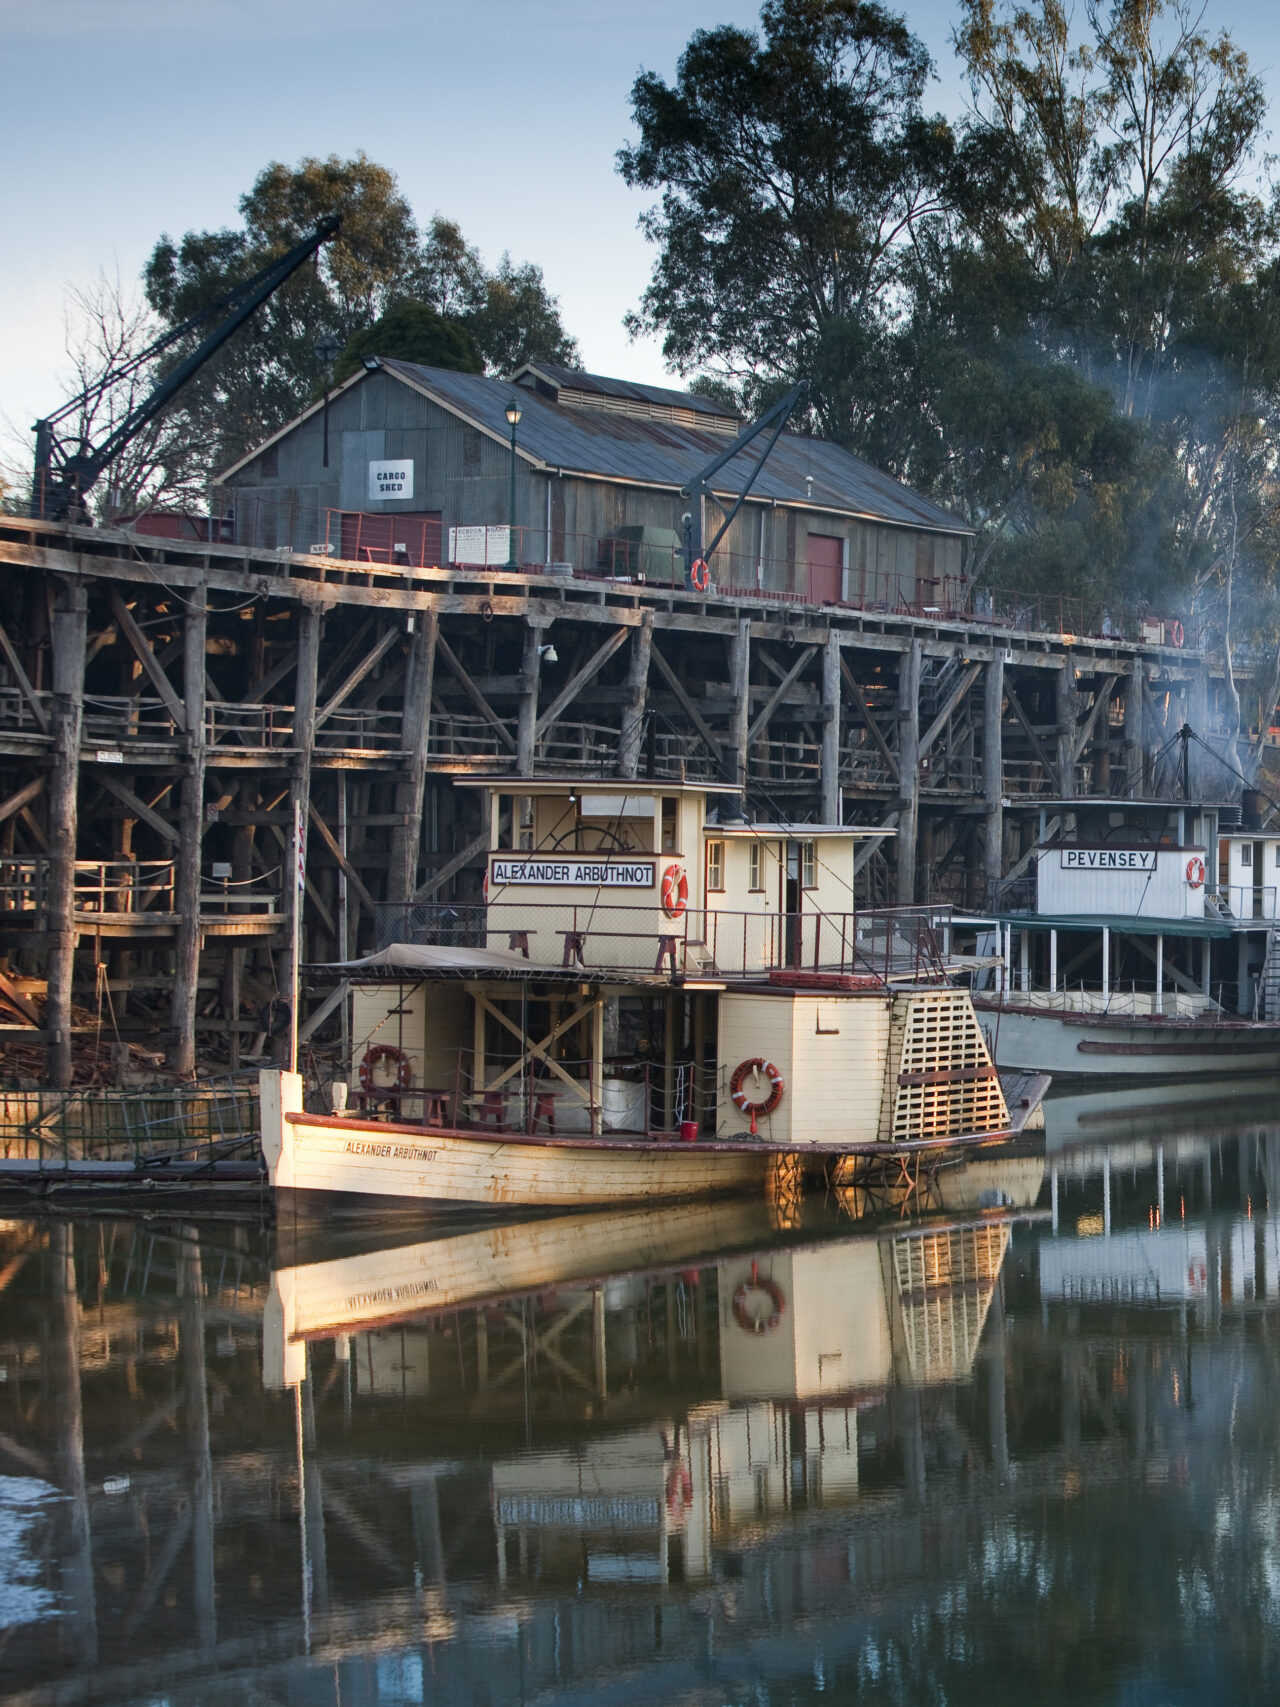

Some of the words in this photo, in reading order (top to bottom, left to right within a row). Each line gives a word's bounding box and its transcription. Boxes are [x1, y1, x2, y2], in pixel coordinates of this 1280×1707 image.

[376, 472, 406, 481] CARGO
[379, 483, 403, 492] SHED
[1067, 851, 1149, 867] PEVENSEY
[495, 864, 570, 881] ALEXANDER
[575, 865, 652, 883] ARBUTHNOT
[345, 1141, 392, 1158] ALEXANDER
[393, 1147, 438, 1162] ARBUTHNOT
